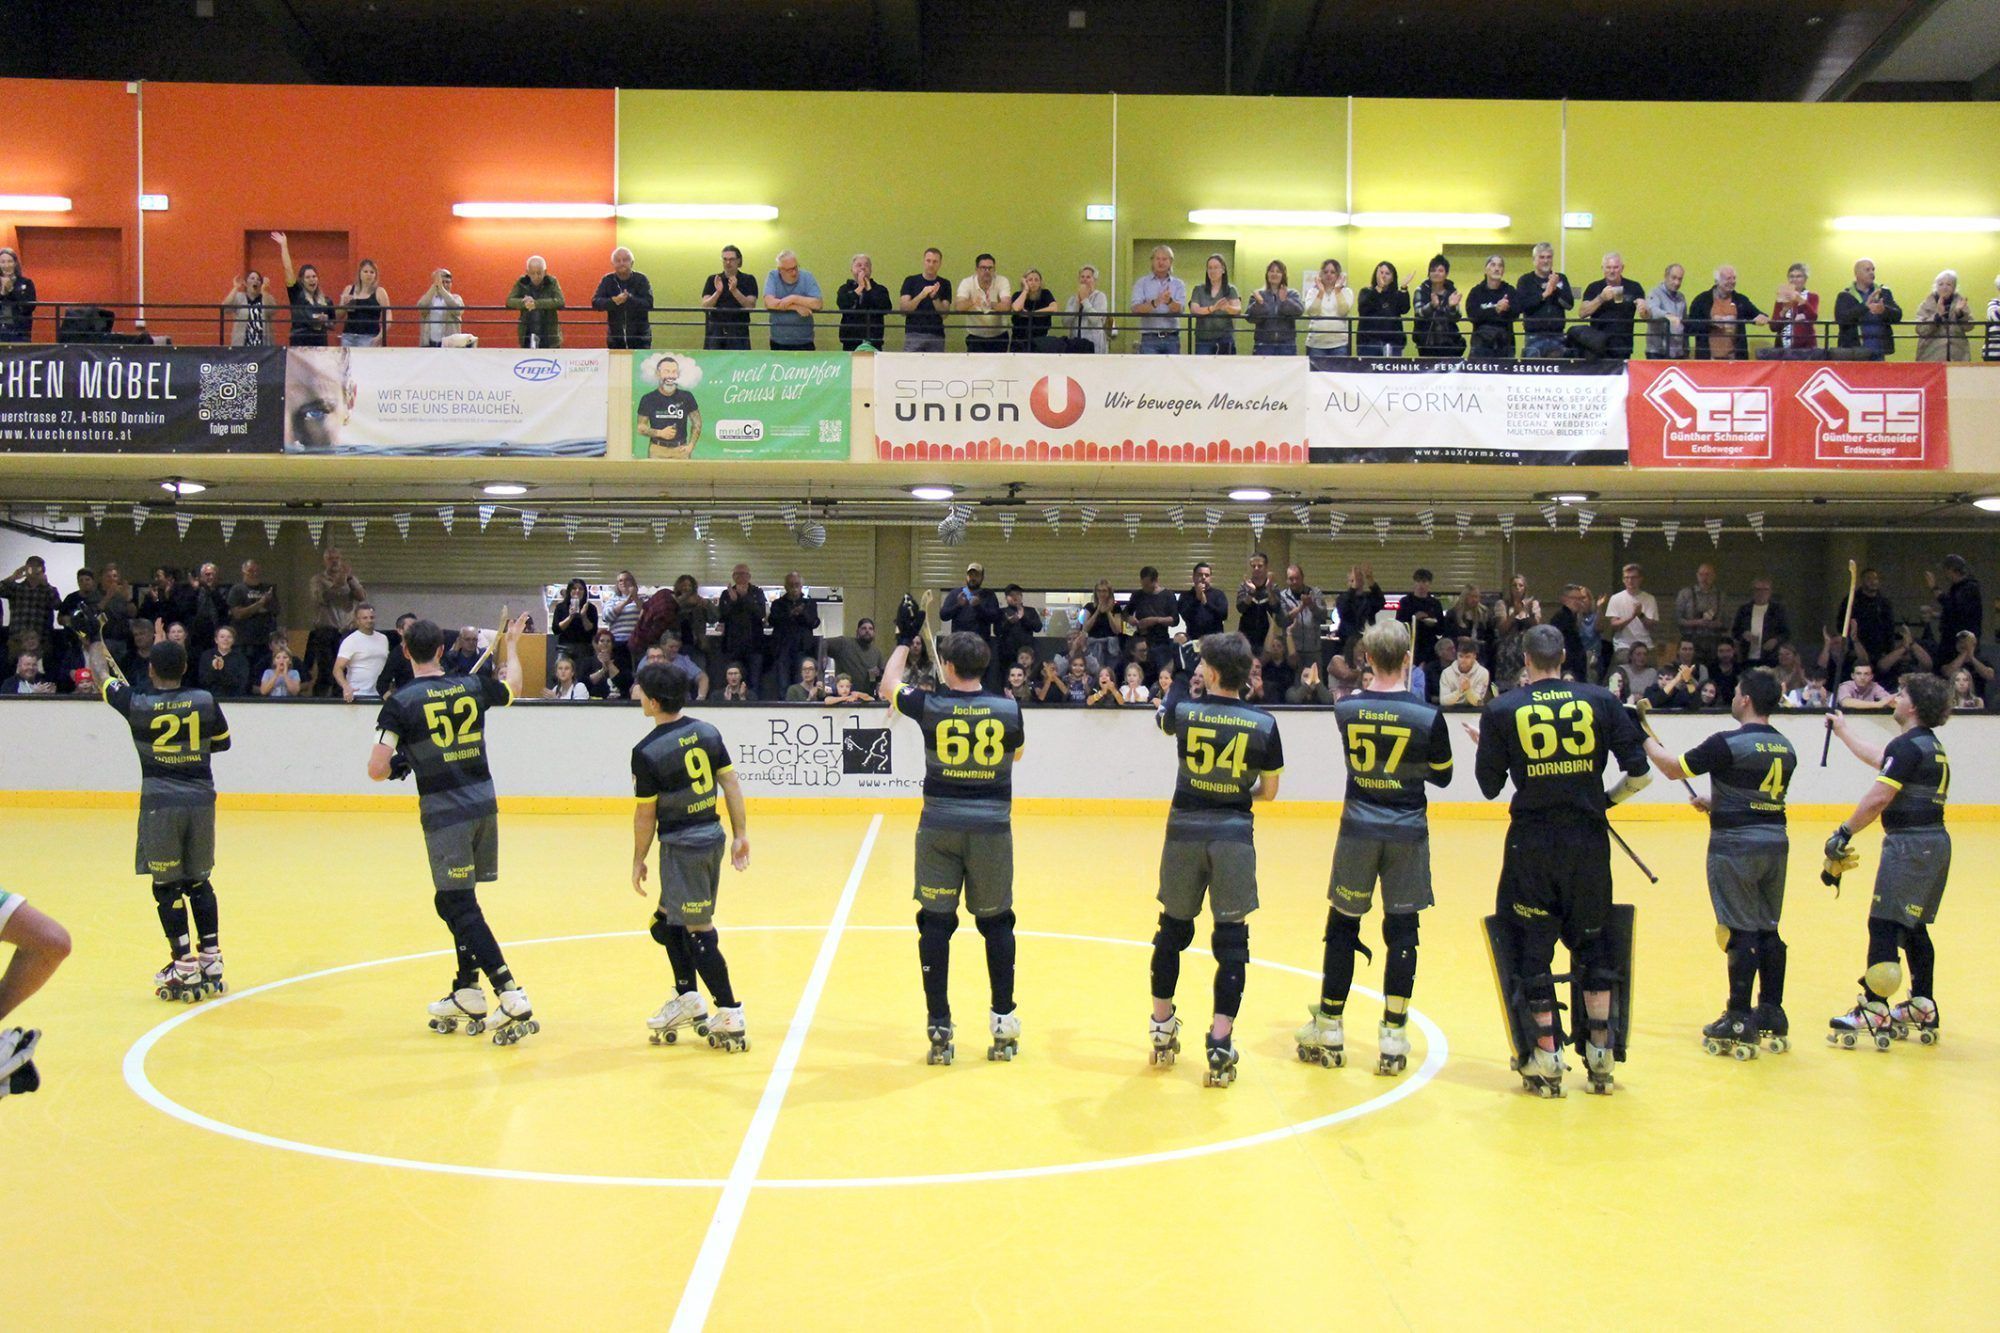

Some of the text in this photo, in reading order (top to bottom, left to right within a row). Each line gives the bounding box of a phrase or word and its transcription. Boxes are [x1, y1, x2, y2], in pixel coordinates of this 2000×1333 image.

[732, 362, 766, 383] weil
[770, 360, 841, 386] Dampfen
[1434, 363, 1500, 372] FERTIGKEIT
[1512, 364, 1560, 373] SERVICE
[0, 357, 177, 400] HEN MÖBEL
[377, 390, 402, 401] WIR
[406, 390, 464, 401] TAUCHEN
[468, 390, 484, 401] DA
[723, 384, 776, 405] Genuss
[895, 379, 1019, 399] SPORT
[1104, 391, 1289, 417] Wir bewegen Menschen
[1507, 394, 1565, 402] GESCHMACK
[377, 403, 523, 415] WO SIE UNS BRAUCHEN.
[1507, 403, 1608, 411] VERANTWORTUNG
[1, 411, 57, 423] uerstrasse
[81, 411, 117, 424] A-6850
[121, 411, 165, 424] Dornbirn
[1507, 411, 1540, 419] DESIGN
[210, 423, 248, 436] folge uns!
[1507, 420, 1548, 428] ELEGANZ
[1670, 431, 1765, 443] Günther Schneider
[1822, 432, 1918, 444] Günther Schneider
[1691, 444, 1743, 455] Erdbeweger
[1844, 445, 1896, 456] Erdbeweger
[1532, 690, 1572, 701] Sohm
[952, 705, 991, 715] Jochum
[1359, 709, 1399, 722] Fässler
[423, 696, 482, 748] 52
[1199, 712, 1258, 729] Lechleitner
[150, 711, 200, 753] 21
[1515, 700, 1596, 760] 63
[935, 718, 1005, 766] 68
[1347, 724, 1412, 774] 57
[739, 743, 844, 768] Hockey
[1186, 727, 1249, 778] 54
[684, 747, 714, 795] 9
[768, 764, 841, 786] Club
[1527, 760, 1594, 777] DORNBIRN
[1191, 778, 1240, 793] DORNBIRN
[1354, 775, 1403, 789] DORNBIRN
[1759, 758, 1784, 800] 4
